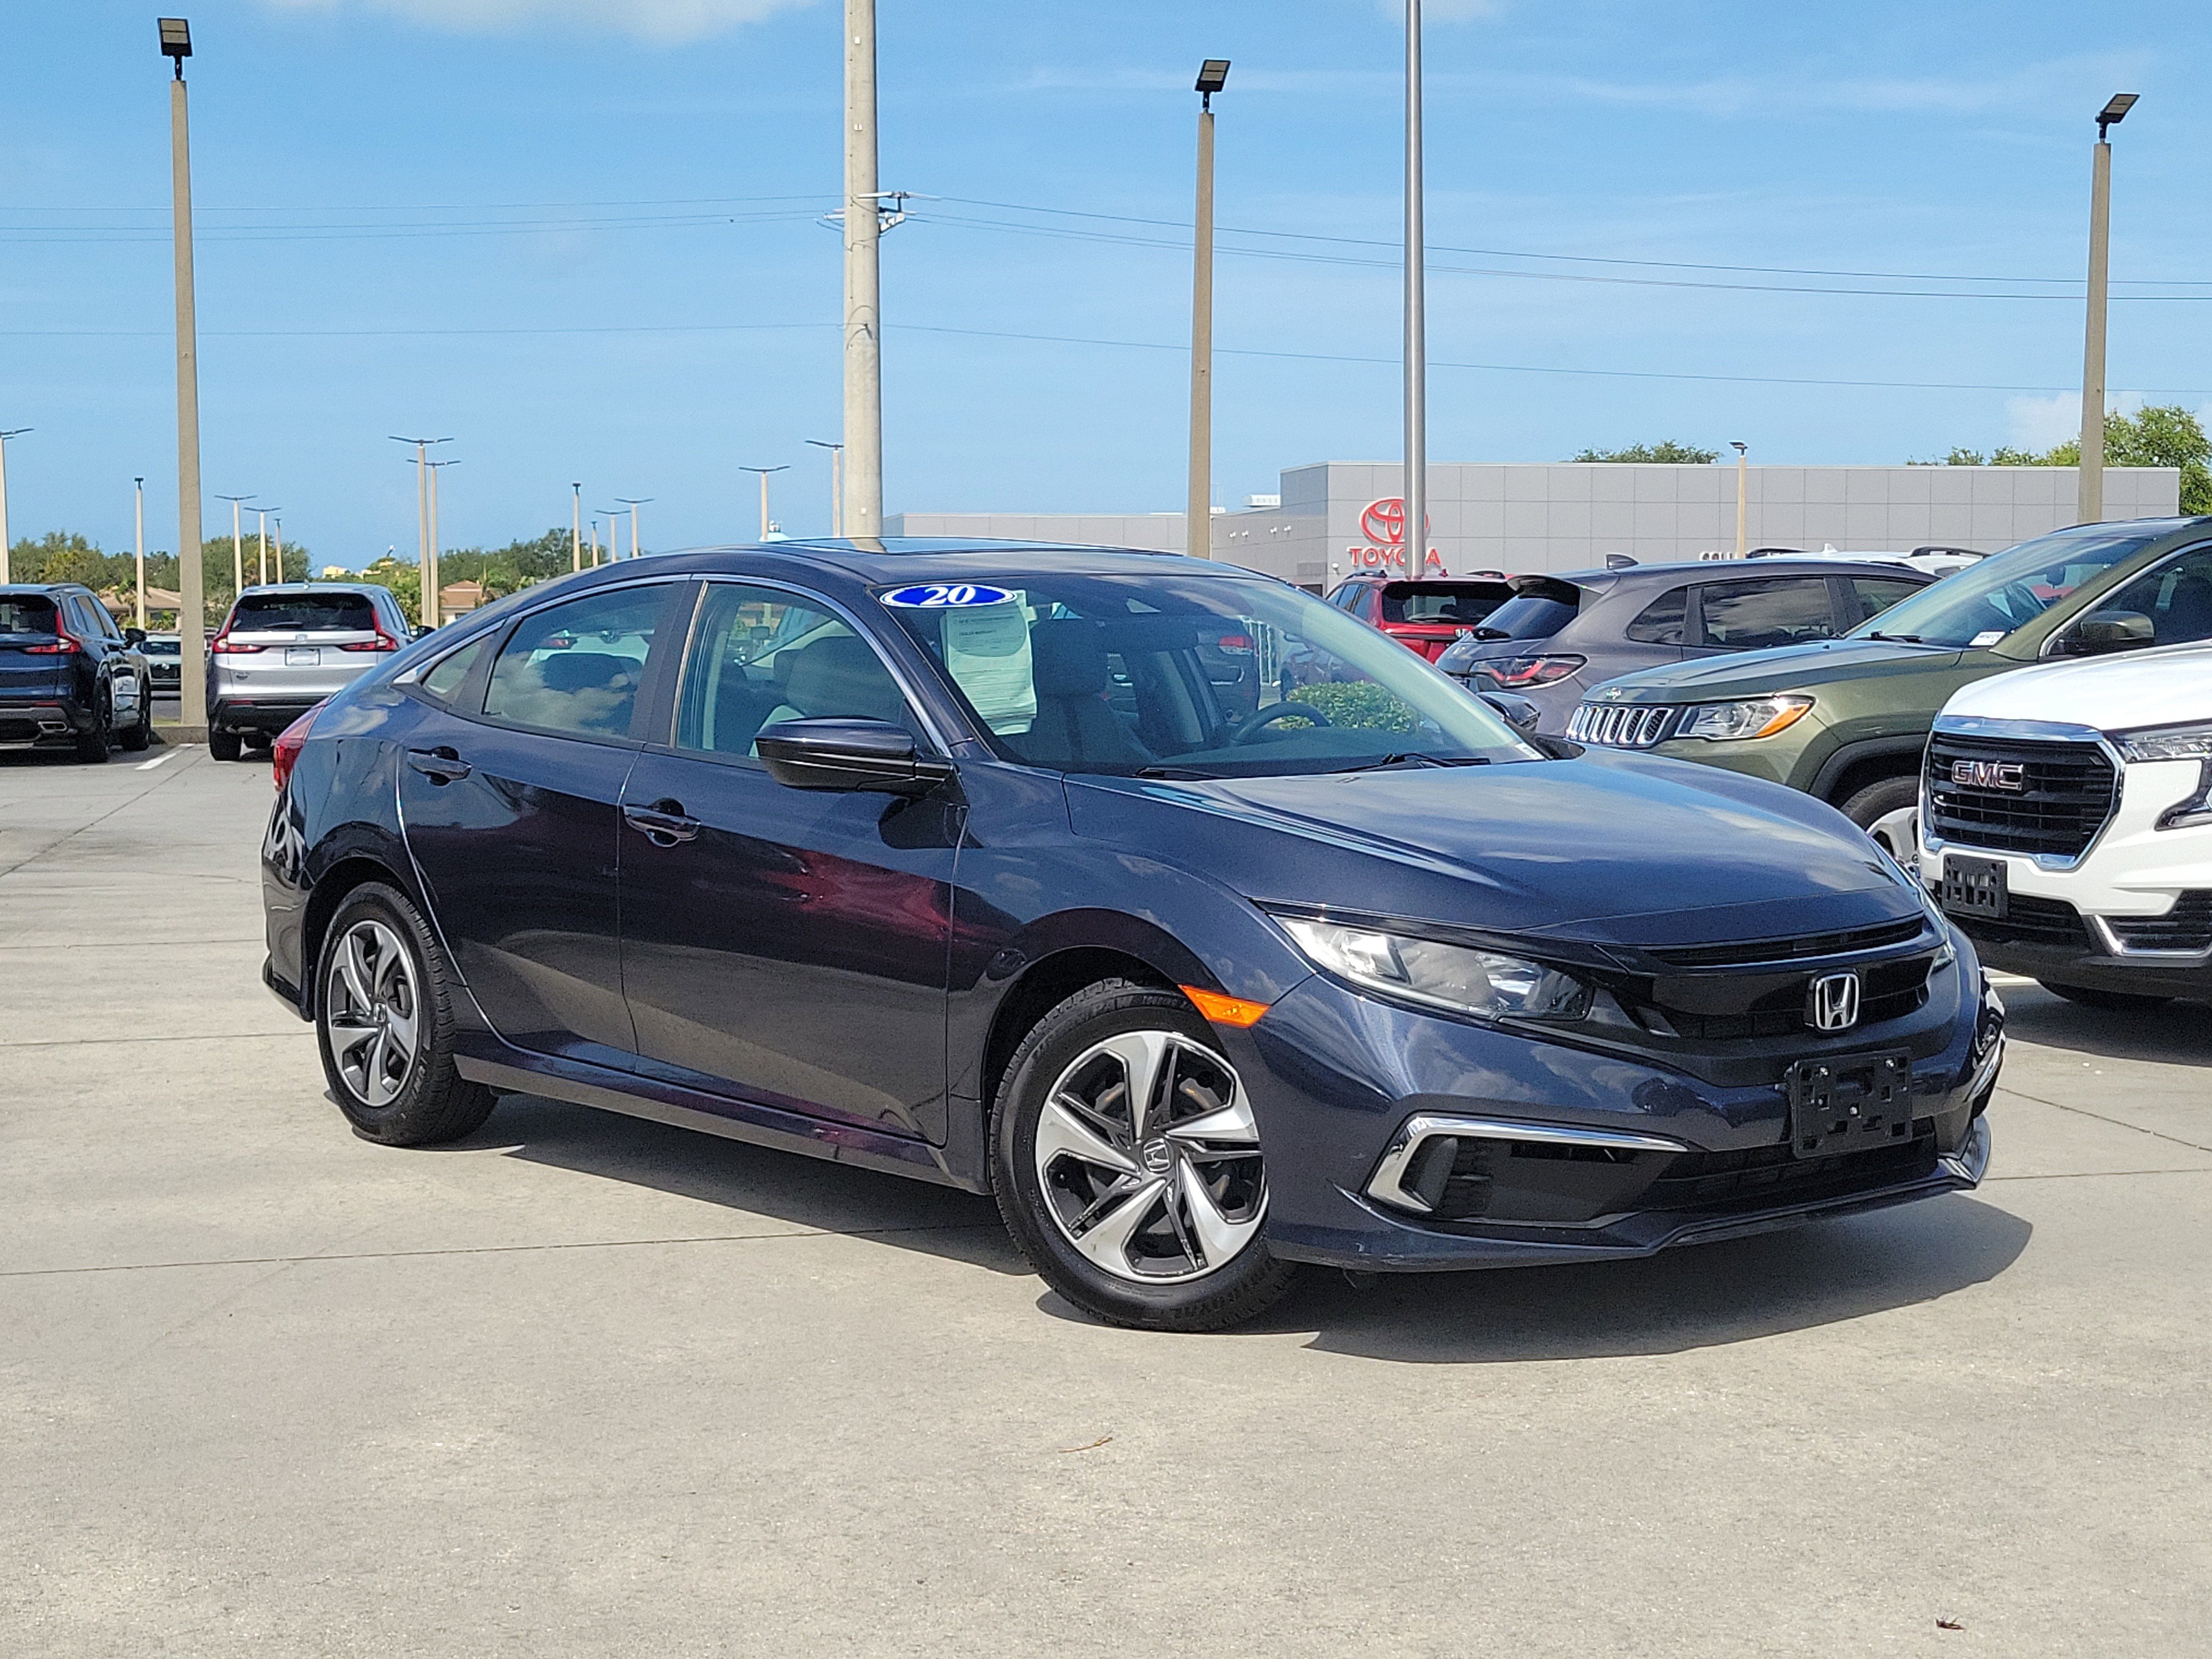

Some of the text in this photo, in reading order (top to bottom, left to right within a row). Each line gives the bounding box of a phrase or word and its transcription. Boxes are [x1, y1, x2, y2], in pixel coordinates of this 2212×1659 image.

[1347, 547, 1442, 566] TOYOA
[919, 586, 976, 606] 20
[1951, 759, 2023, 791] GMC
